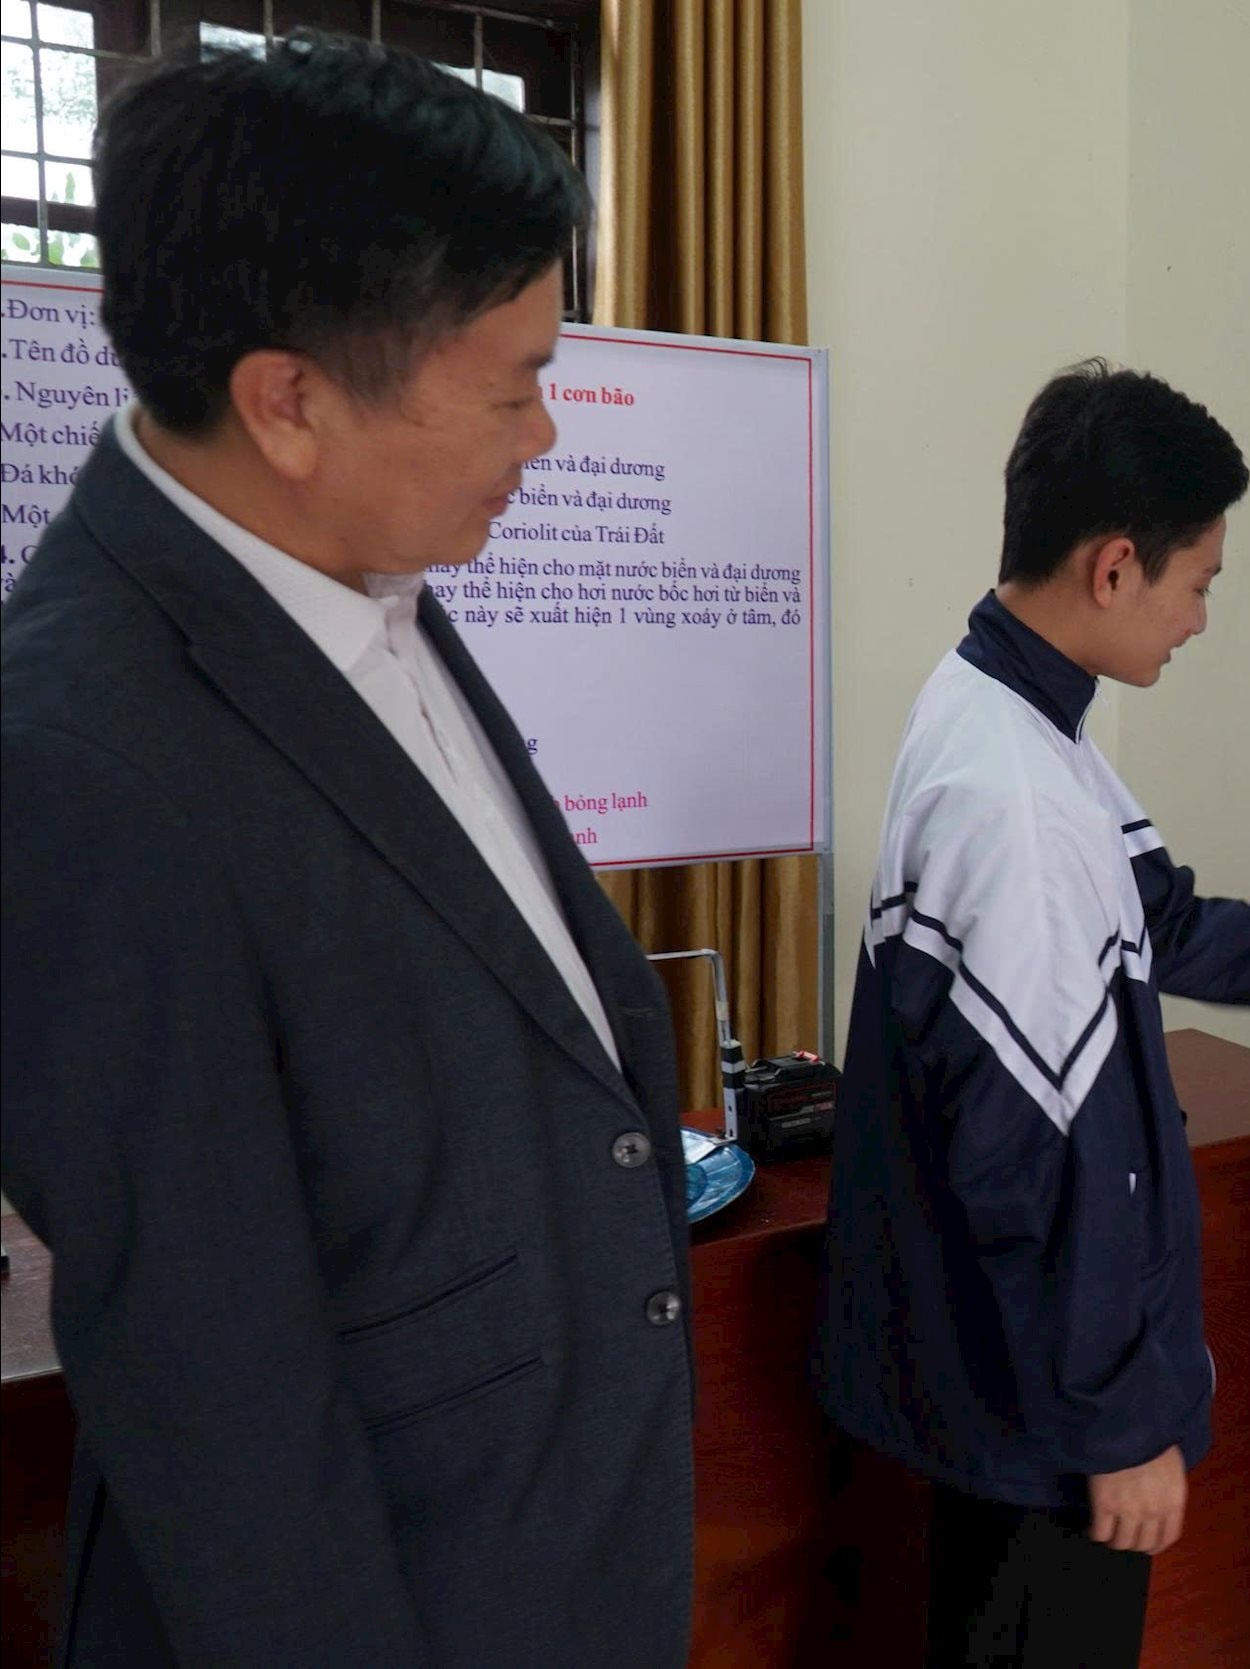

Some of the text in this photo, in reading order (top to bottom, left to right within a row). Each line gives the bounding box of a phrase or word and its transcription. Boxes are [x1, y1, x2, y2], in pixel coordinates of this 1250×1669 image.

[65, 304, 95, 330] vị:
[61, 337, 90, 364] đồ
[14, 381, 110, 410] Nguyên
[550, 383, 557, 400] 1
[563, 387, 597, 403] cơn
[601, 386, 635, 406] bão
[0, 421, 48, 447] Một
[0, 463, 33, 484] Đá
[555, 454, 576, 472] và
[580, 455, 607, 477] đại
[610, 457, 665, 482] dương
[1, 504, 50, 528] Một
[561, 490, 582, 507] và
[585, 491, 612, 511] đại
[616, 492, 671, 516] dương
[488, 521, 665, 545] Coriolit của Trái Đất
[499, 557, 538, 578] hiện
[542, 558, 575, 576] cho
[579, 560, 611, 580] mặt
[615, 561, 657, 577] nước
[700, 563, 720, 580] và
[723, 563, 747, 583] đại
[750, 564, 801, 585] dương
[496, 581, 536, 602] hiện
[541, 582, 573, 600] cho
[578, 582, 606, 601] hơi
[611, 584, 654, 601] nước
[693, 584, 719, 602] hơi
[783, 587, 801, 603] và
[465, 606, 499, 627] này
[504, 606, 524, 623] sẽ
[530, 601, 569, 623] xuất
[574, 606, 611, 627] hiện
[620, 607, 626, 624] 1
[634, 607, 676, 628] vùng
[681, 608, 722, 629] xoáy
[742, 608, 776, 627] tâm,
[781, 609, 801, 626] đó
[612, 792, 648, 812] lạnh
